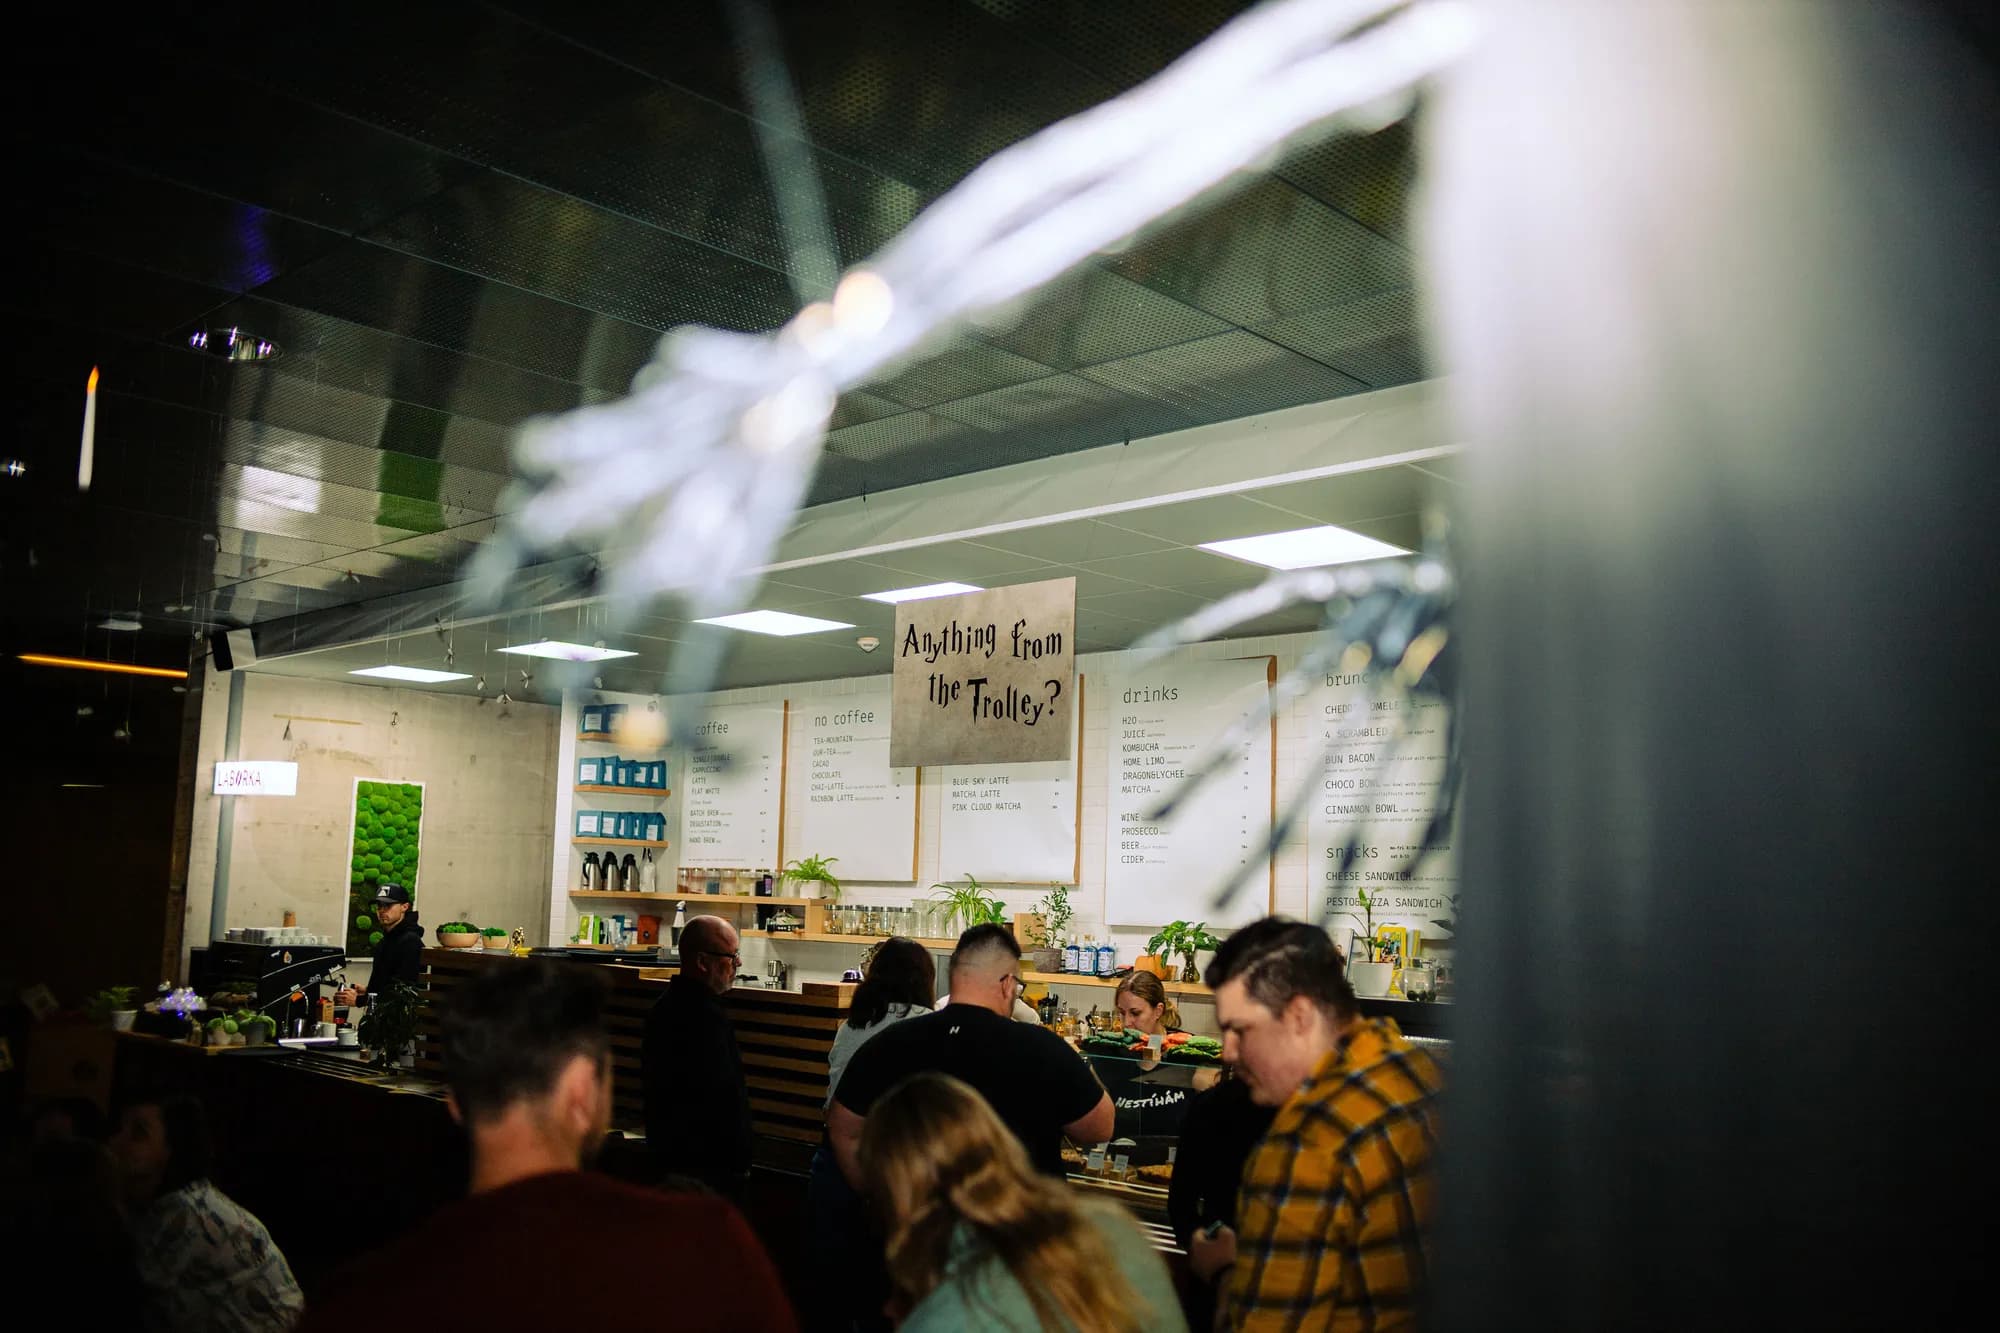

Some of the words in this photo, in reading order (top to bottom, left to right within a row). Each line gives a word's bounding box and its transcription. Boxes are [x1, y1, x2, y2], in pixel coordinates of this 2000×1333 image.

[902, 620, 997, 663] Anything
[1011, 618, 1062, 661] from
[1326, 672, 1370, 687] brunc
[928, 671, 961, 709] the
[966, 678, 1062, 726] Trolley?
[1123, 685, 1179, 704] drinks
[814, 715, 828, 727] no
[834, 709, 875, 726] coffee
[1122, 716, 1137, 725] H2O
[695, 720, 729, 736] coffee
[1122, 729, 1146, 739] JUICE
[1122, 743, 1160, 753] KOMBUCHA
[1123, 757, 1141, 767] HOME
[1145, 756, 1166, 766] LIMO
[1325, 754, 1344, 765] BUN
[1348, 753, 1376, 764] BACON
[952, 777, 969, 786] BLUE
[972, 777, 986, 785] SKY
[989, 776, 1010, 785] LATTE
[1325, 780, 1355, 790] CHOCO
[811, 782, 845, 791] CHAI-LATTE
[1121, 784, 1152, 794] MATCHA
[837, 794, 854, 802] LATTE
[952, 790, 977, 798] MATCHA
[980, 789, 1001, 798] LATTE
[952, 803, 968, 811] PINK
[971, 802, 992, 811] CLOUD
[995, 801, 1022, 810] MATCHA
[1325, 804, 1371, 815] CINNAMON
[1375, 803, 1399, 814] BOWL
[1121, 812, 1140, 822] WINE
[1121, 826, 1159, 836] PROSECCO
[1121, 841, 1140, 850] BEER
[1121, 855, 1145, 865] CIDER
[1325, 871, 1360, 881] CHEESE
[1364, 871, 1412, 881] SANDWICH
[1395, 897, 1443, 909] SANDWICH
